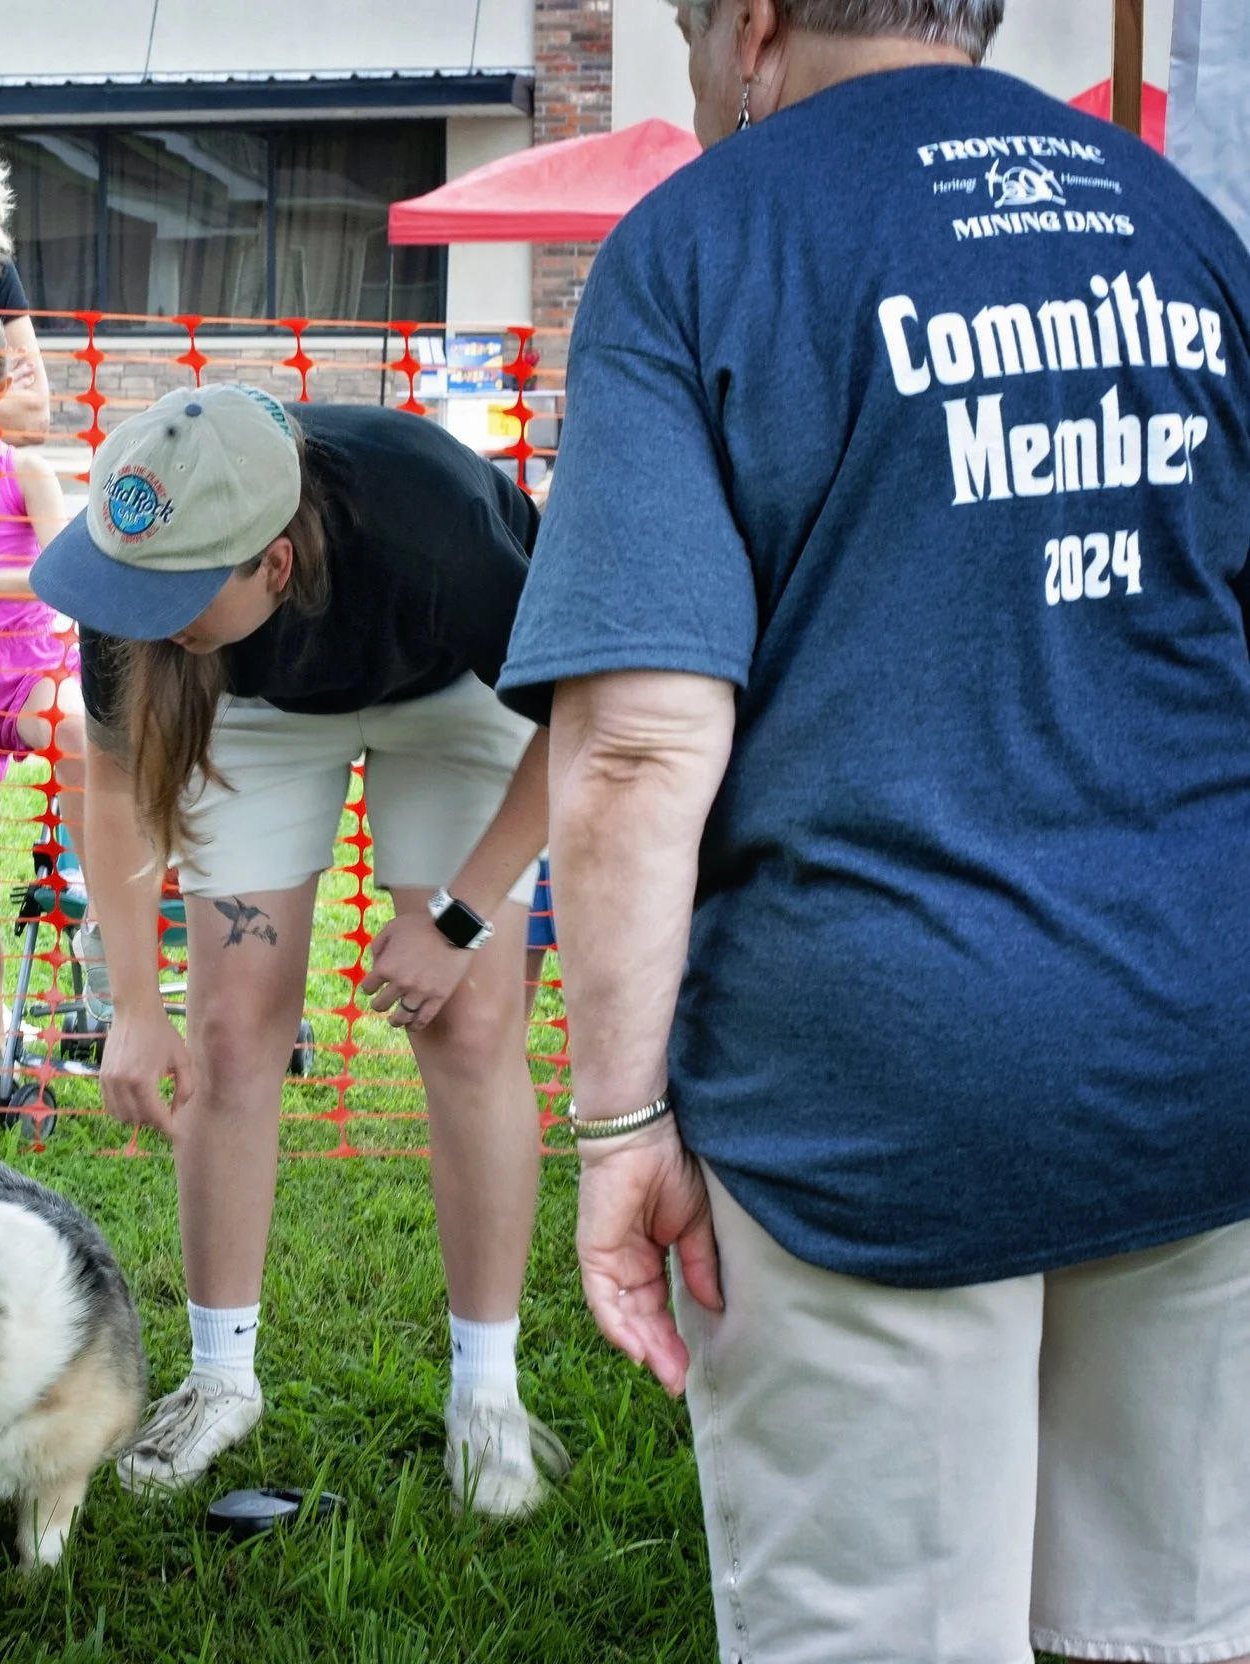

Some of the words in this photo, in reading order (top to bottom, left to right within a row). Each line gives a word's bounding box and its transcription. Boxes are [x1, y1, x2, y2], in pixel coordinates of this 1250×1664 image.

[917, 135, 1106, 167] FRONTENAC
[933, 176, 977, 195] Heritage
[1060, 172, 1123, 196] Homecoming
[952, 210, 1061, 242] MINING
[1063, 210, 1135, 237] DAYS
[878, 270, 1227, 396] Committee
[942, 384, 1209, 506] Member
[103, 473, 136, 506] Hard
[132, 488, 175, 526] Rock
[1044, 529, 1143, 607] 2024
